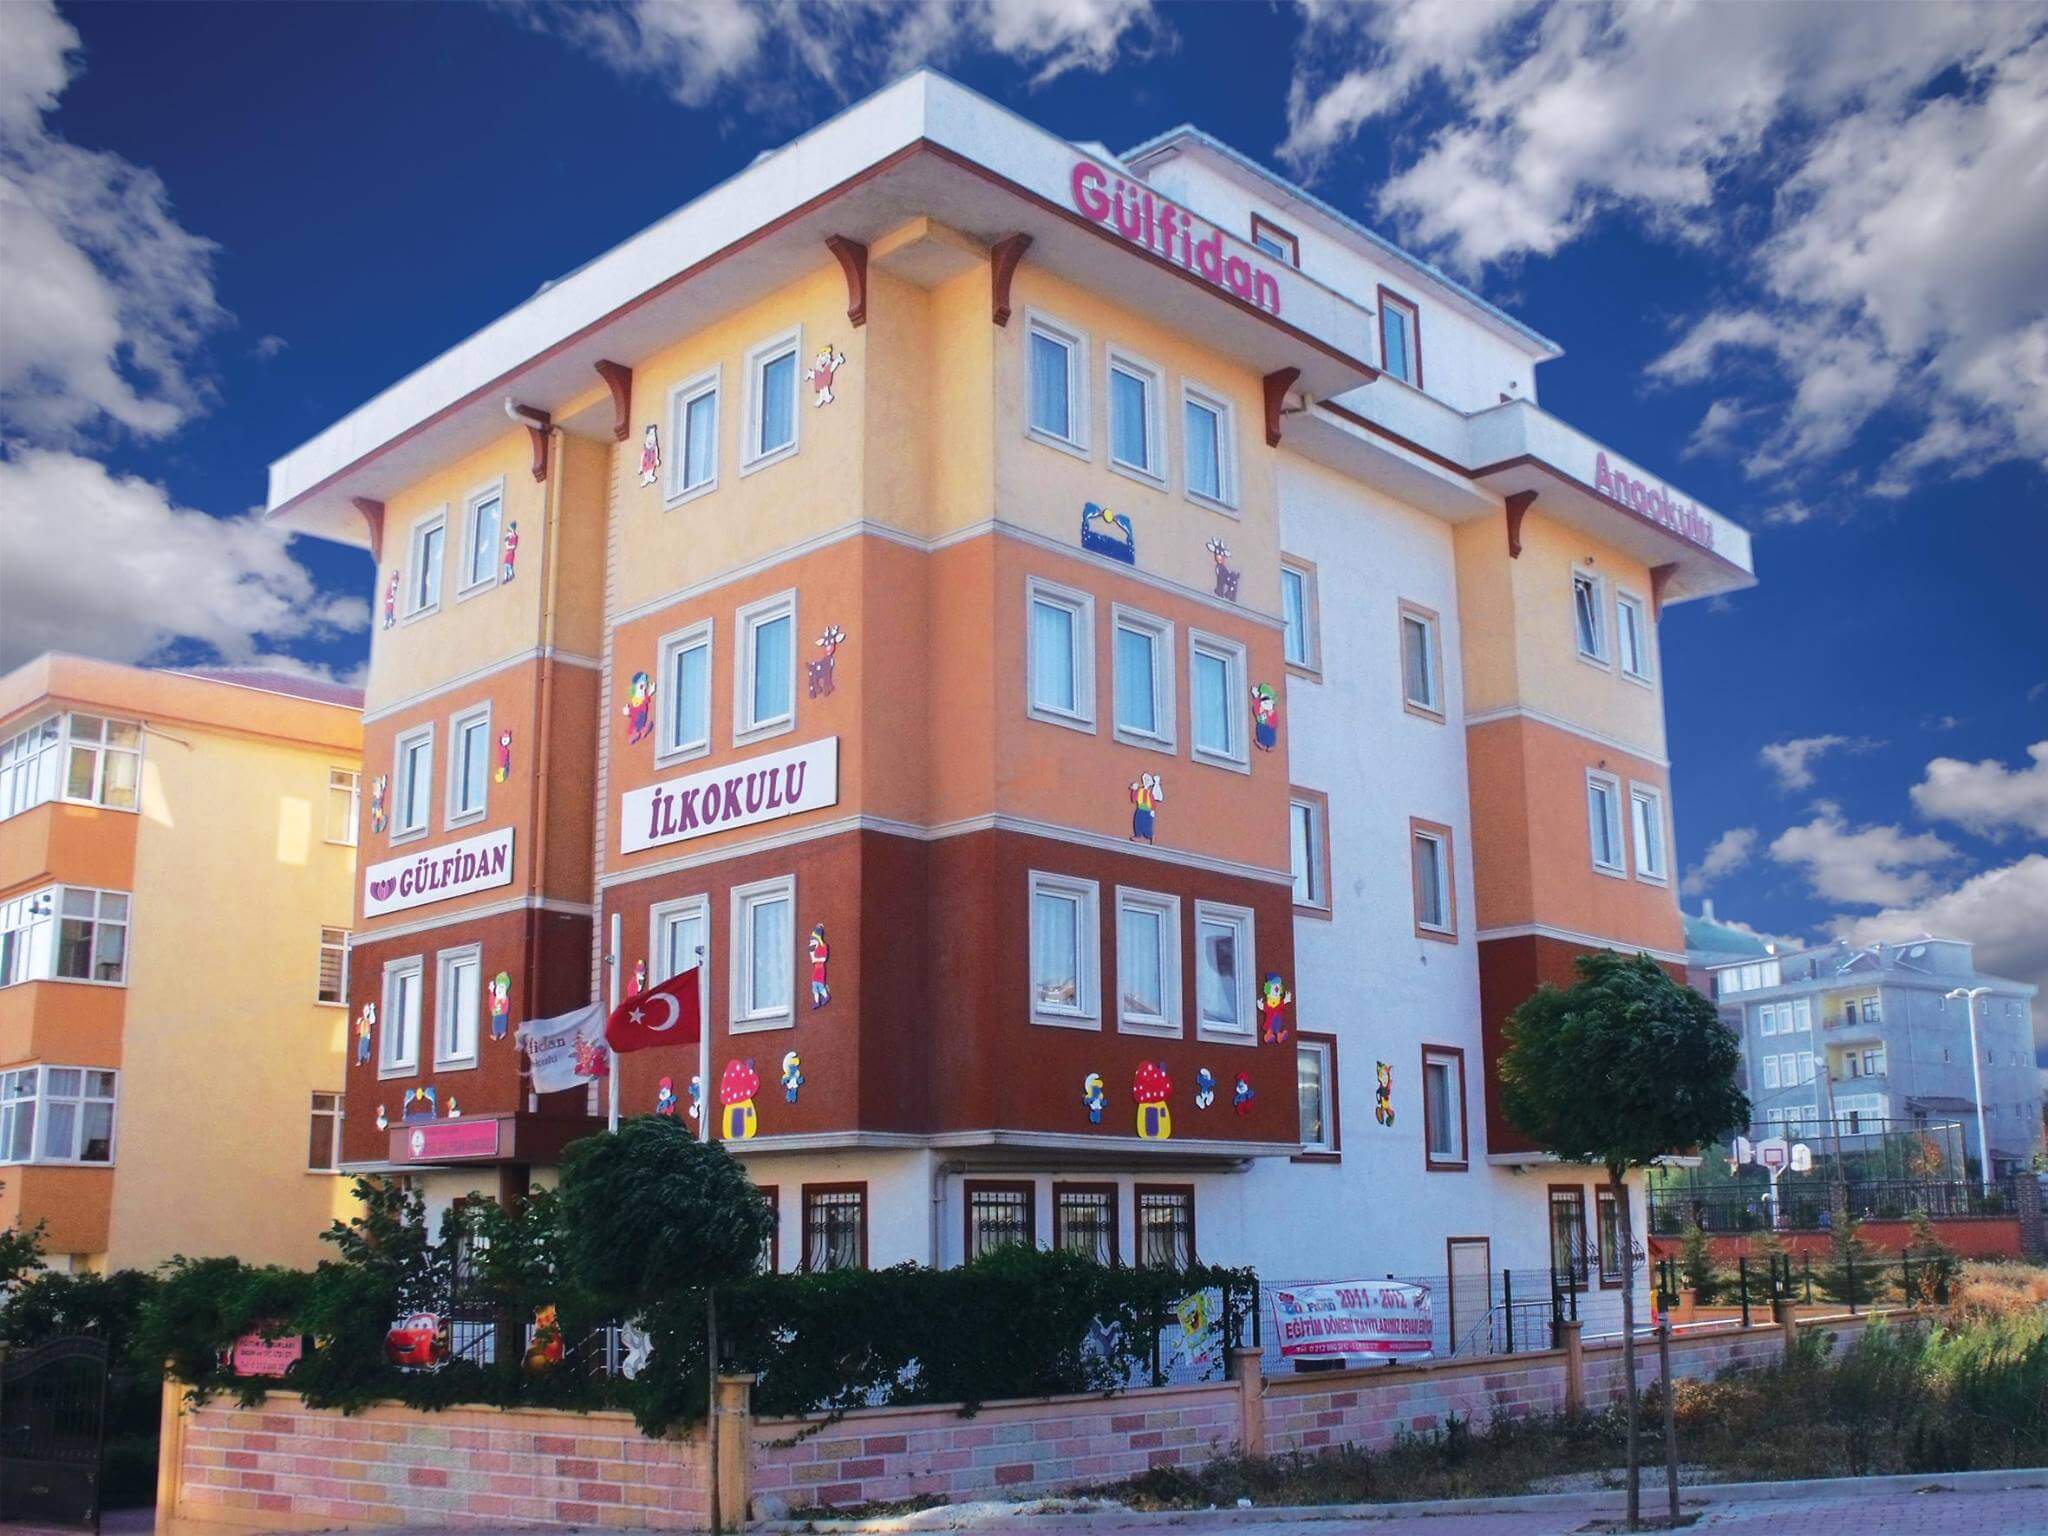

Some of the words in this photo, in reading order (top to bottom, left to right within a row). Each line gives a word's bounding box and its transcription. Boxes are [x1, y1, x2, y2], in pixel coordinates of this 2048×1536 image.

[1072, 161, 1280, 315] Gülfidan
[649, 760, 807, 839] İLKOKULU
[400, 844, 507, 898] GÜLFİDAN
[1336, 1288, 1370, 1309] 2011
[1379, 1287, 1408, 1309] 2012
[1286, 1315, 1323, 1339] EĞİTİM
